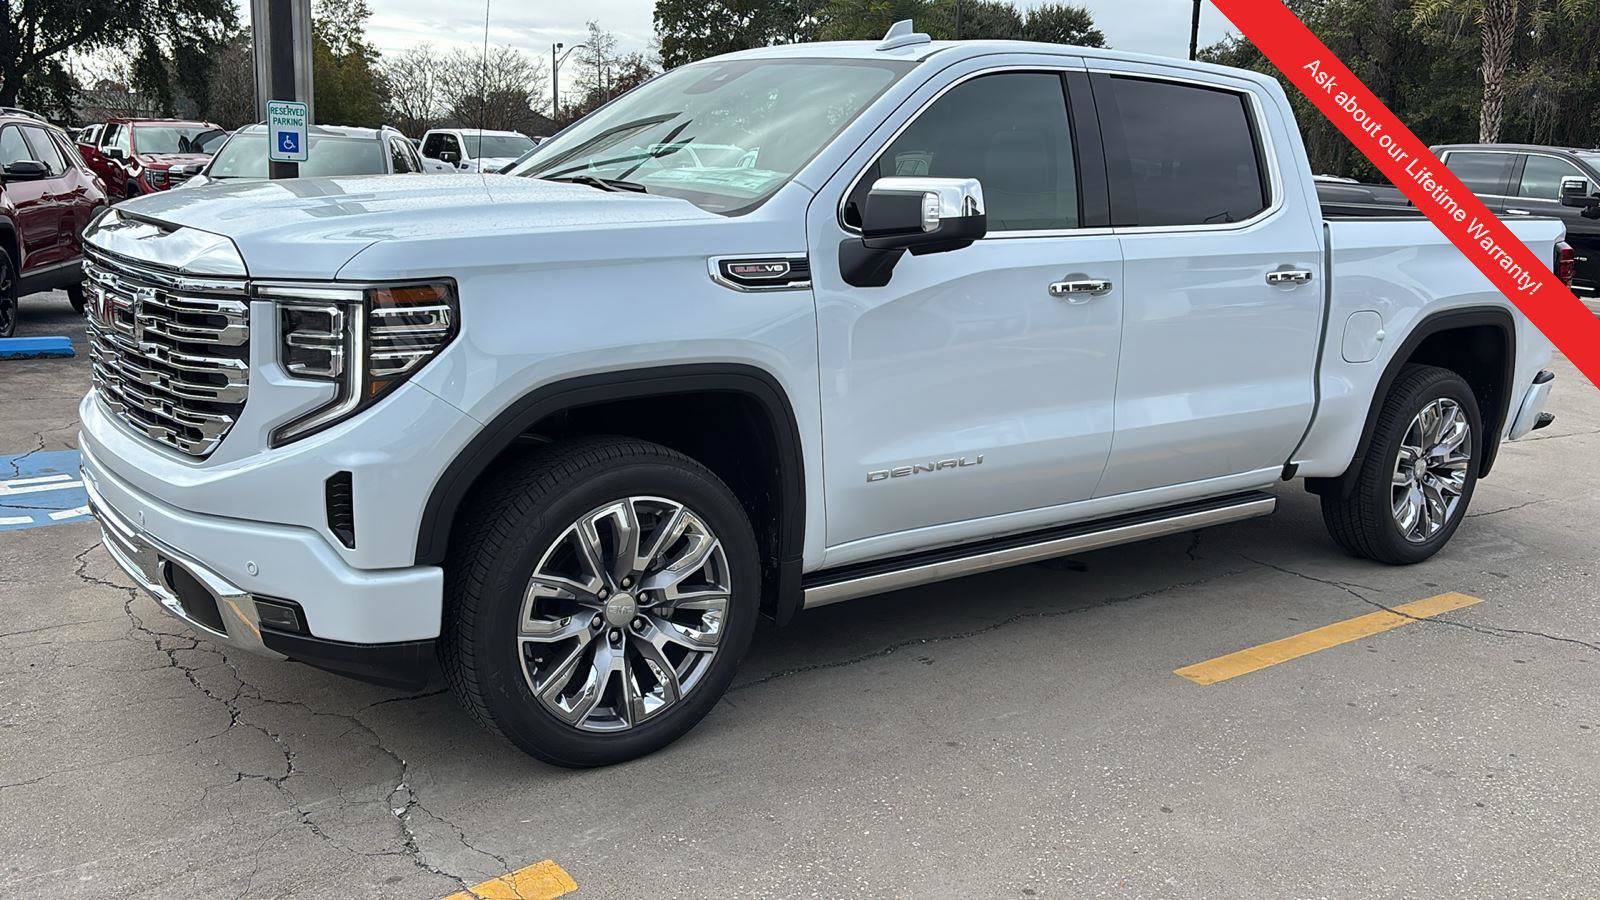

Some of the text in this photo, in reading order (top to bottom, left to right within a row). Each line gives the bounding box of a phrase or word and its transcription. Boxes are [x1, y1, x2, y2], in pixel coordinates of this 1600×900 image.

[270, 107, 304, 116] RESERVED
[273, 118, 303, 126] PARKING
[866, 454, 984, 483] DENALI
